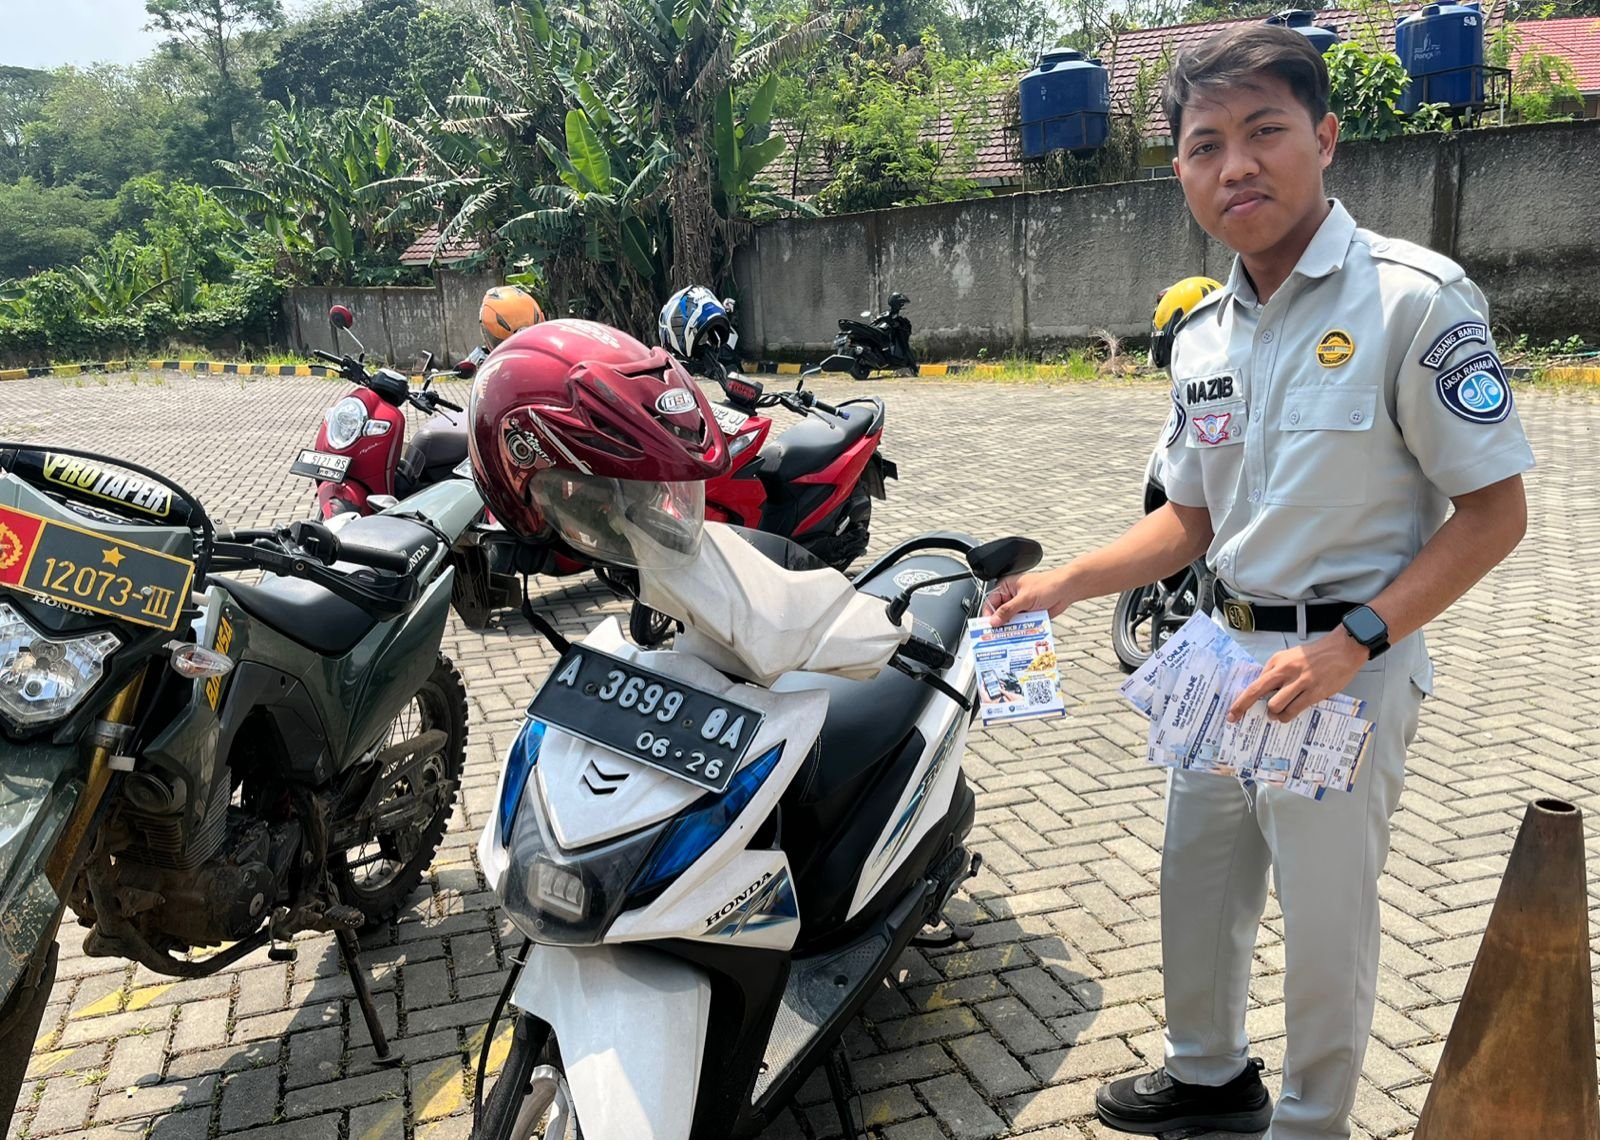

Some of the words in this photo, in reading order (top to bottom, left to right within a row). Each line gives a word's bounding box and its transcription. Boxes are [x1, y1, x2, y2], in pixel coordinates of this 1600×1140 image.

[1430, 334, 1456, 363] CABANG
[1457, 327, 1483, 338] BANTEN
[1187, 376, 1233, 405] NAZIB
[1444, 371, 1463, 390] JASA
[1464, 359, 1494, 376] RAHARJA
[42, 558, 175, 619] 12073-III
[1166, 640, 1190, 663] ONLINE
[558, 655, 582, 686] A
[599, 669, 684, 722] 3699
[1172, 700, 1188, 728] SAMSAT
[1183, 675, 1198, 700] ONLINE
[705, 871, 773, 927] HONDA
